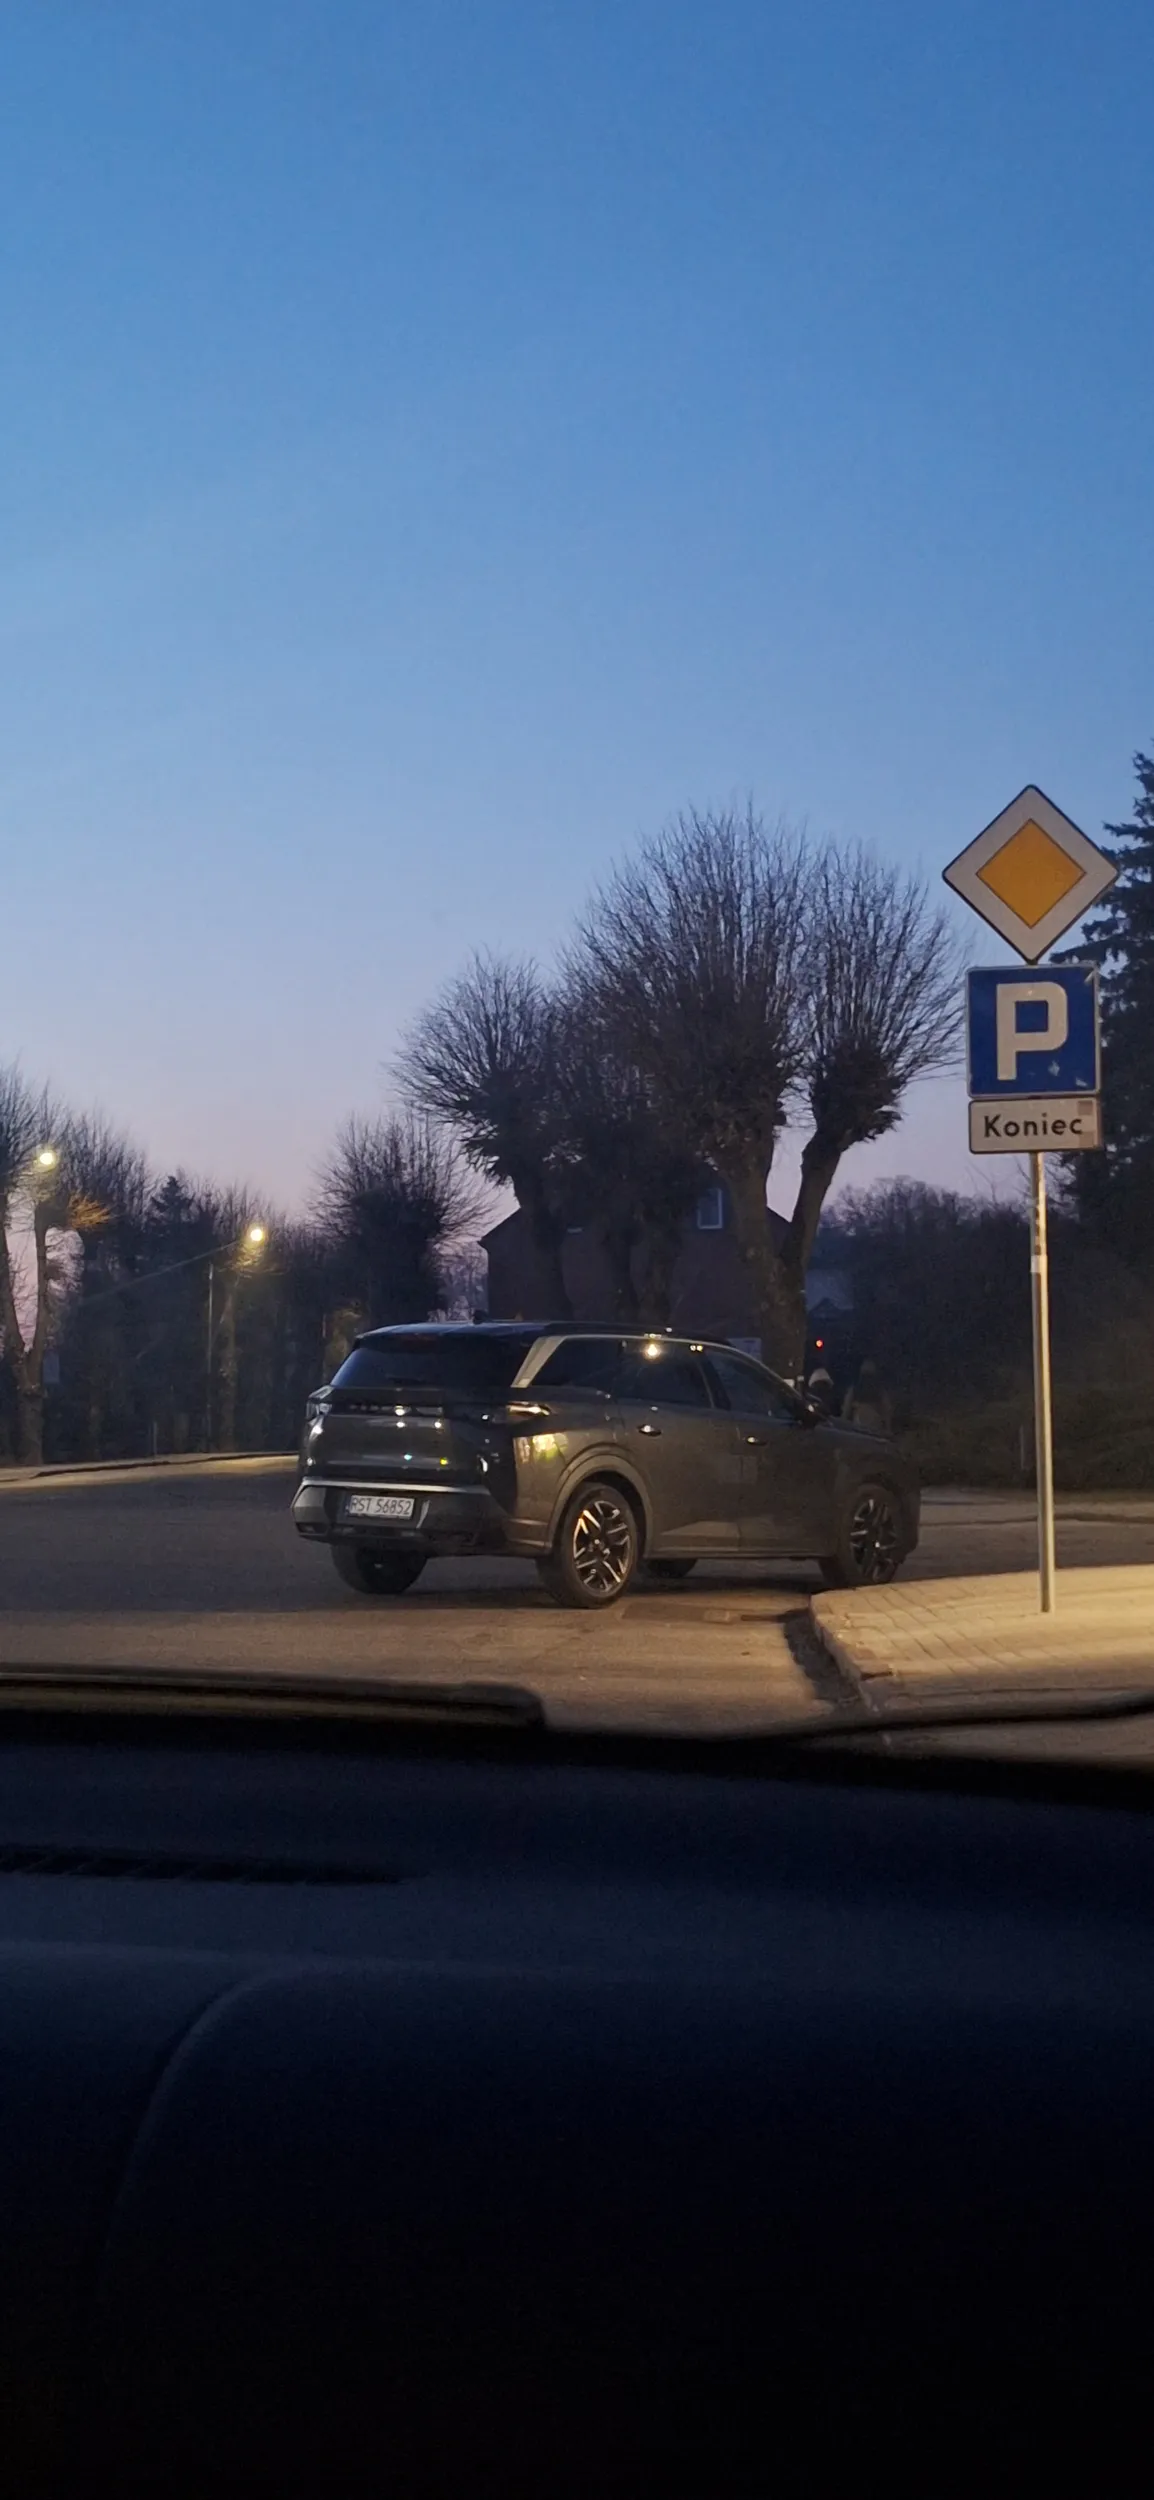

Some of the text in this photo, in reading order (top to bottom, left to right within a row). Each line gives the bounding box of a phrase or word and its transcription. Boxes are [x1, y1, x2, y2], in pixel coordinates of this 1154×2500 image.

[996, 981, 1067, 1080] P
[983, 1112, 1083, 1138] Koniec
[350, 1497, 412, 1515] RST 56852
